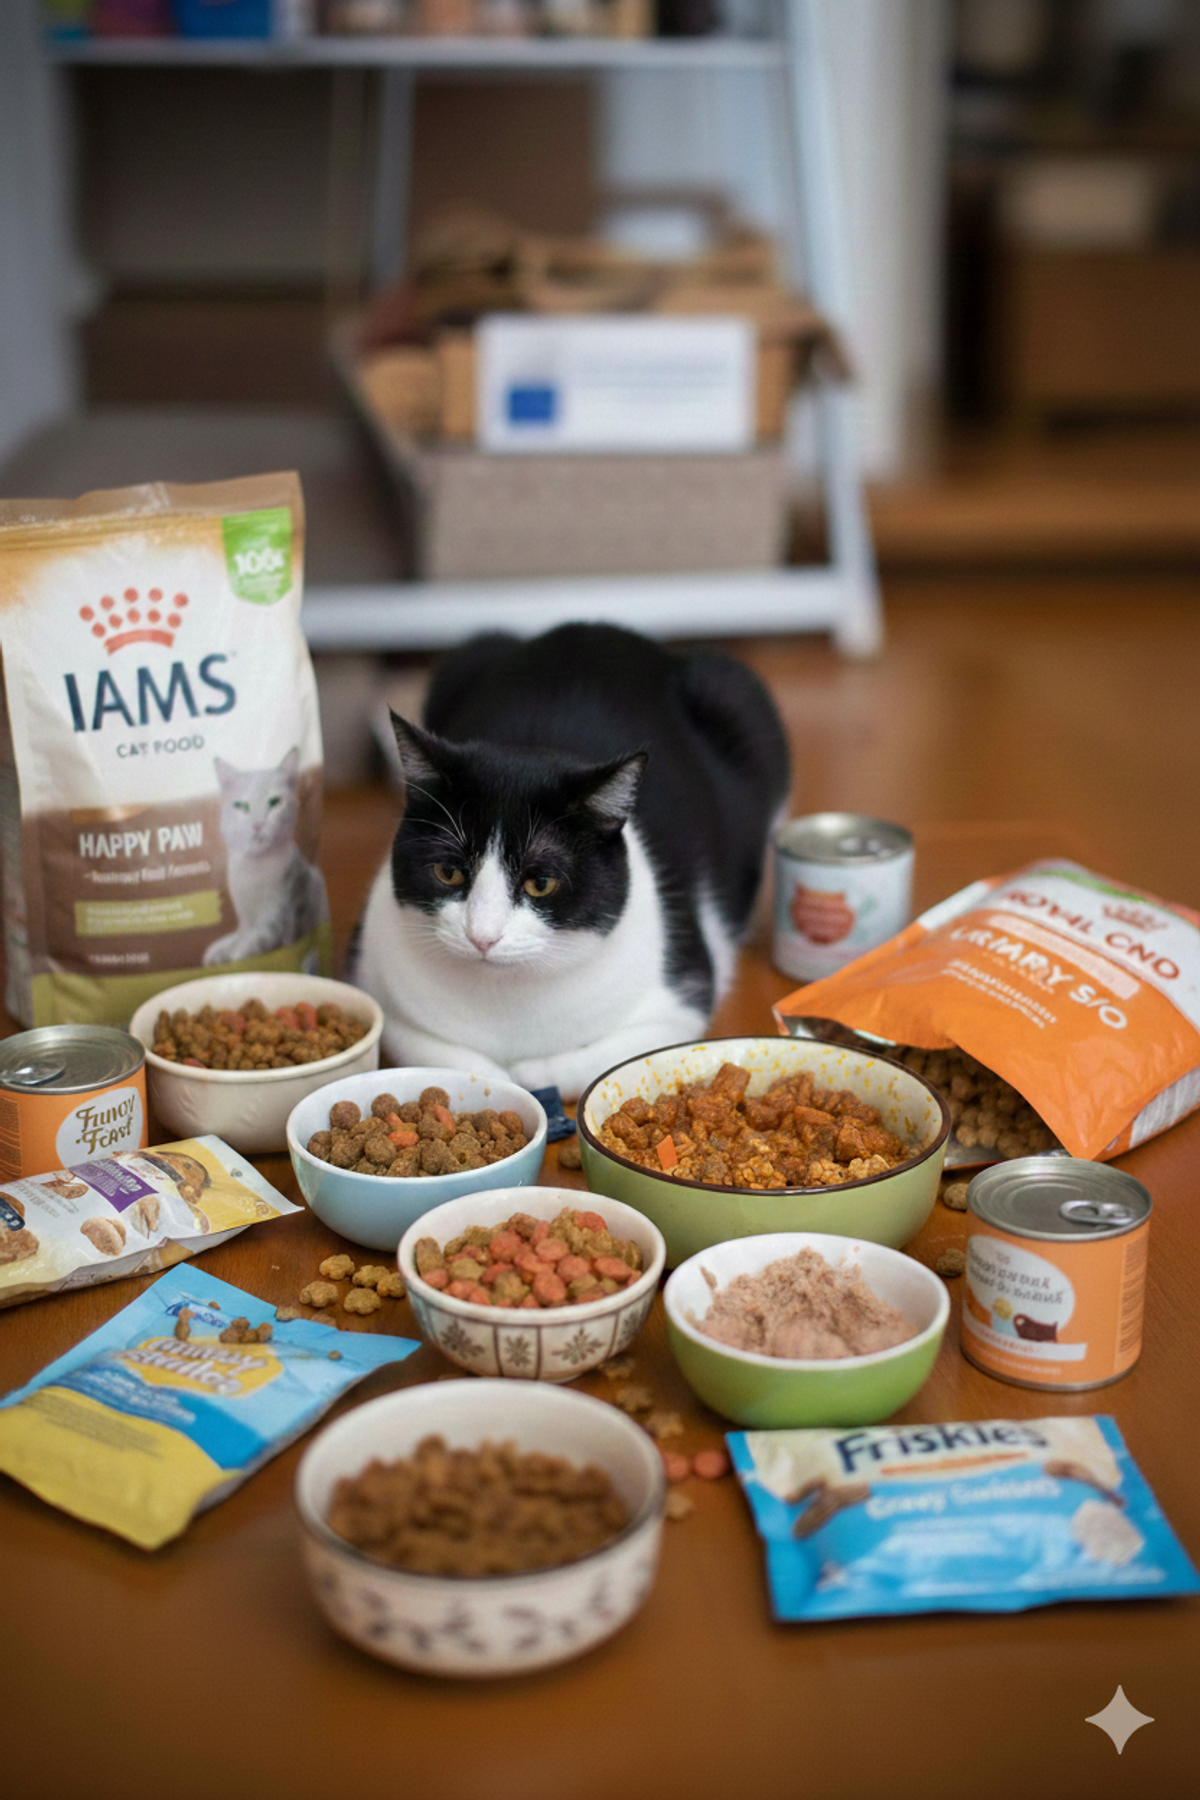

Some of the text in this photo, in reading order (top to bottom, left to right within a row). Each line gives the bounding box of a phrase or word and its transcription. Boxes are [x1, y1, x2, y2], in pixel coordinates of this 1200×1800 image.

[64, 653, 236, 733] IAMS
[116, 734, 206, 759] CAT FOOD
[79, 821, 203, 860] HAPPY PAW
[1105, 932, 1182, 980] CNO
[1069, 984, 1128, 1030] S/O
[835, 1420, 1049, 1474] Friskies
